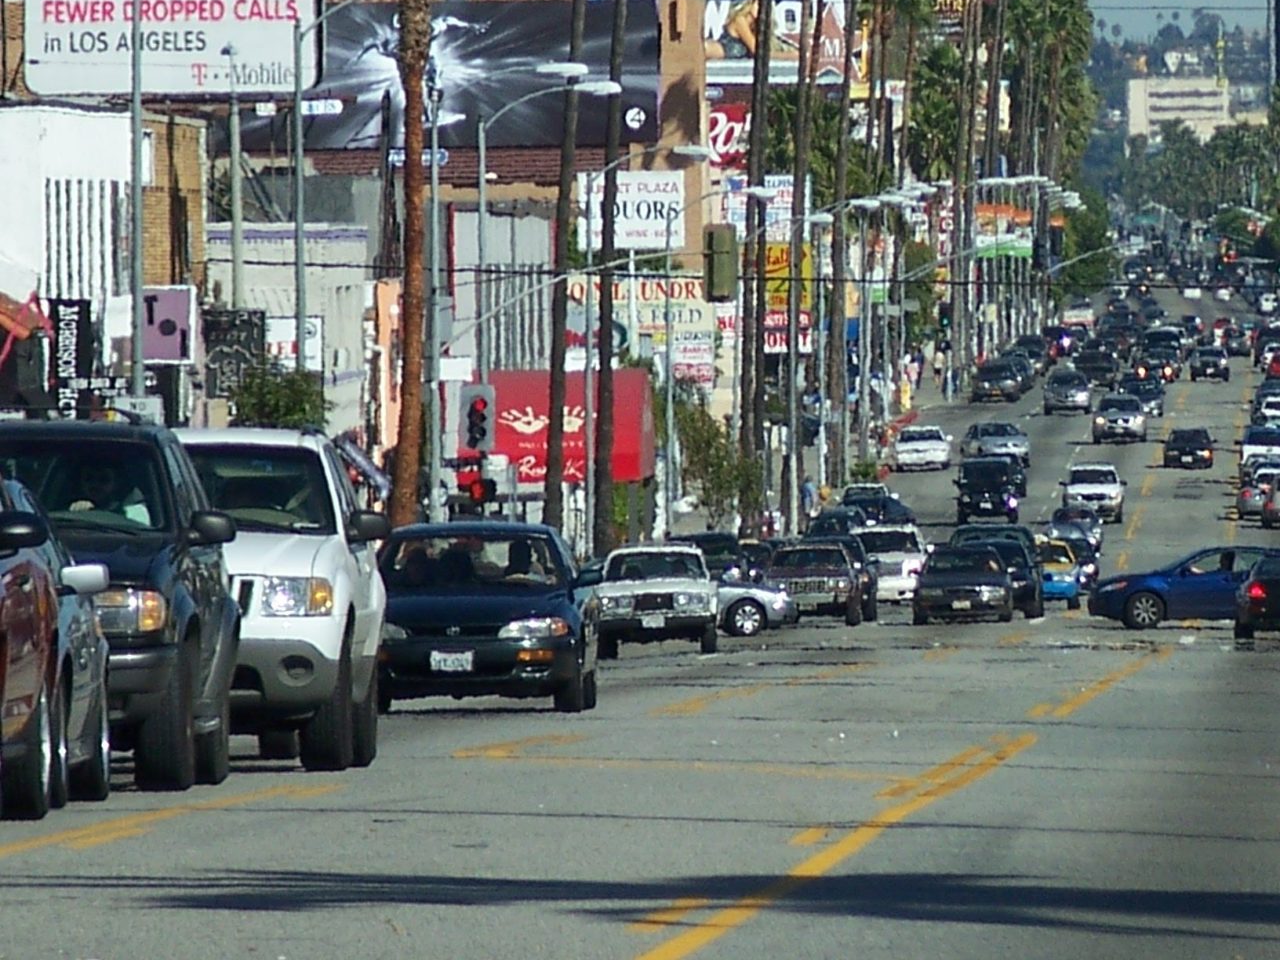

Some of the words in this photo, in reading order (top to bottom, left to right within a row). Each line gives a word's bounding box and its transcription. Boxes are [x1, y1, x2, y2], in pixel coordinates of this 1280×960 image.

[43, 0, 114, 23] FEWER
[44, 33, 61, 54] in
[69, 31, 108, 53] LOS
[232, 62, 294, 86] Mobile
[637, 182, 680, 195] PLAZA
